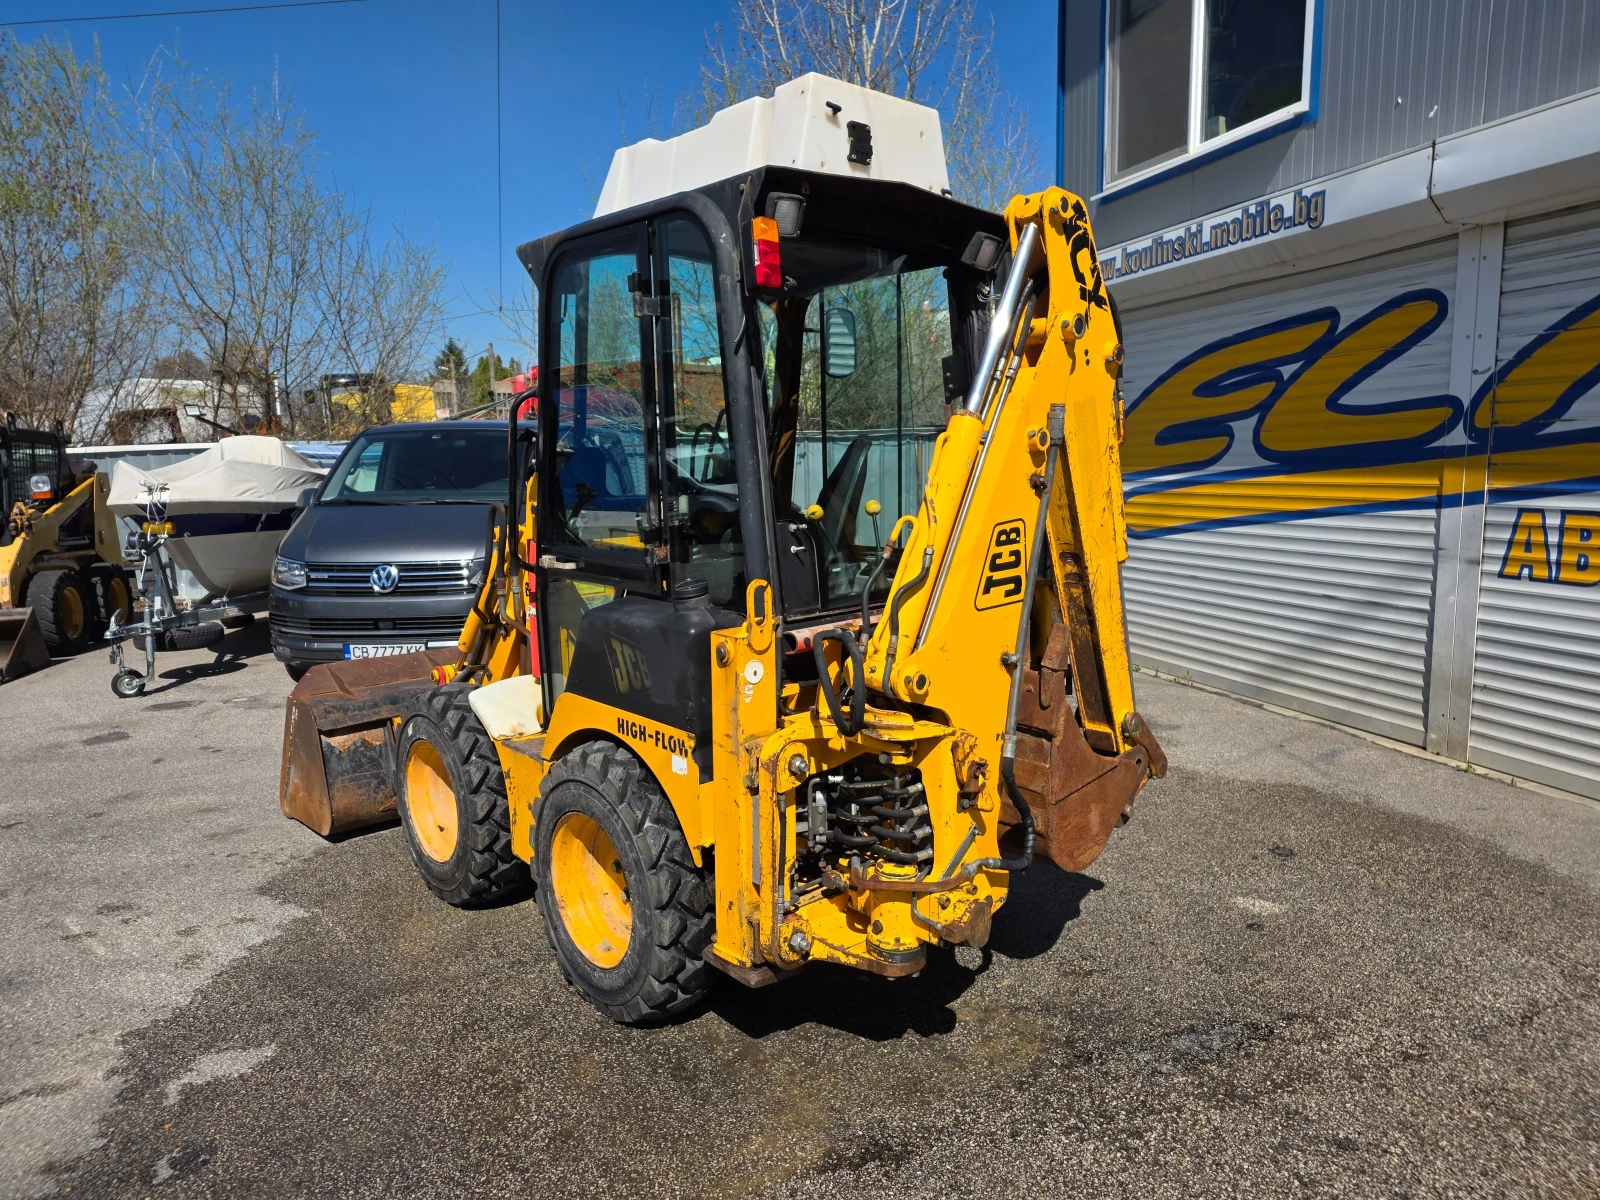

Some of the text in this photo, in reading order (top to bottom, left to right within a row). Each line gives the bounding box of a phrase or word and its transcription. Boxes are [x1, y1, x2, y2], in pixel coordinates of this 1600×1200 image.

[1099, 188, 1326, 281] w.koulinski.mobile.bg
[982, 526, 1023, 599] JCB
[610, 637, 653, 694] JCB
[617, 717, 689, 758] HIGH-FLOW
